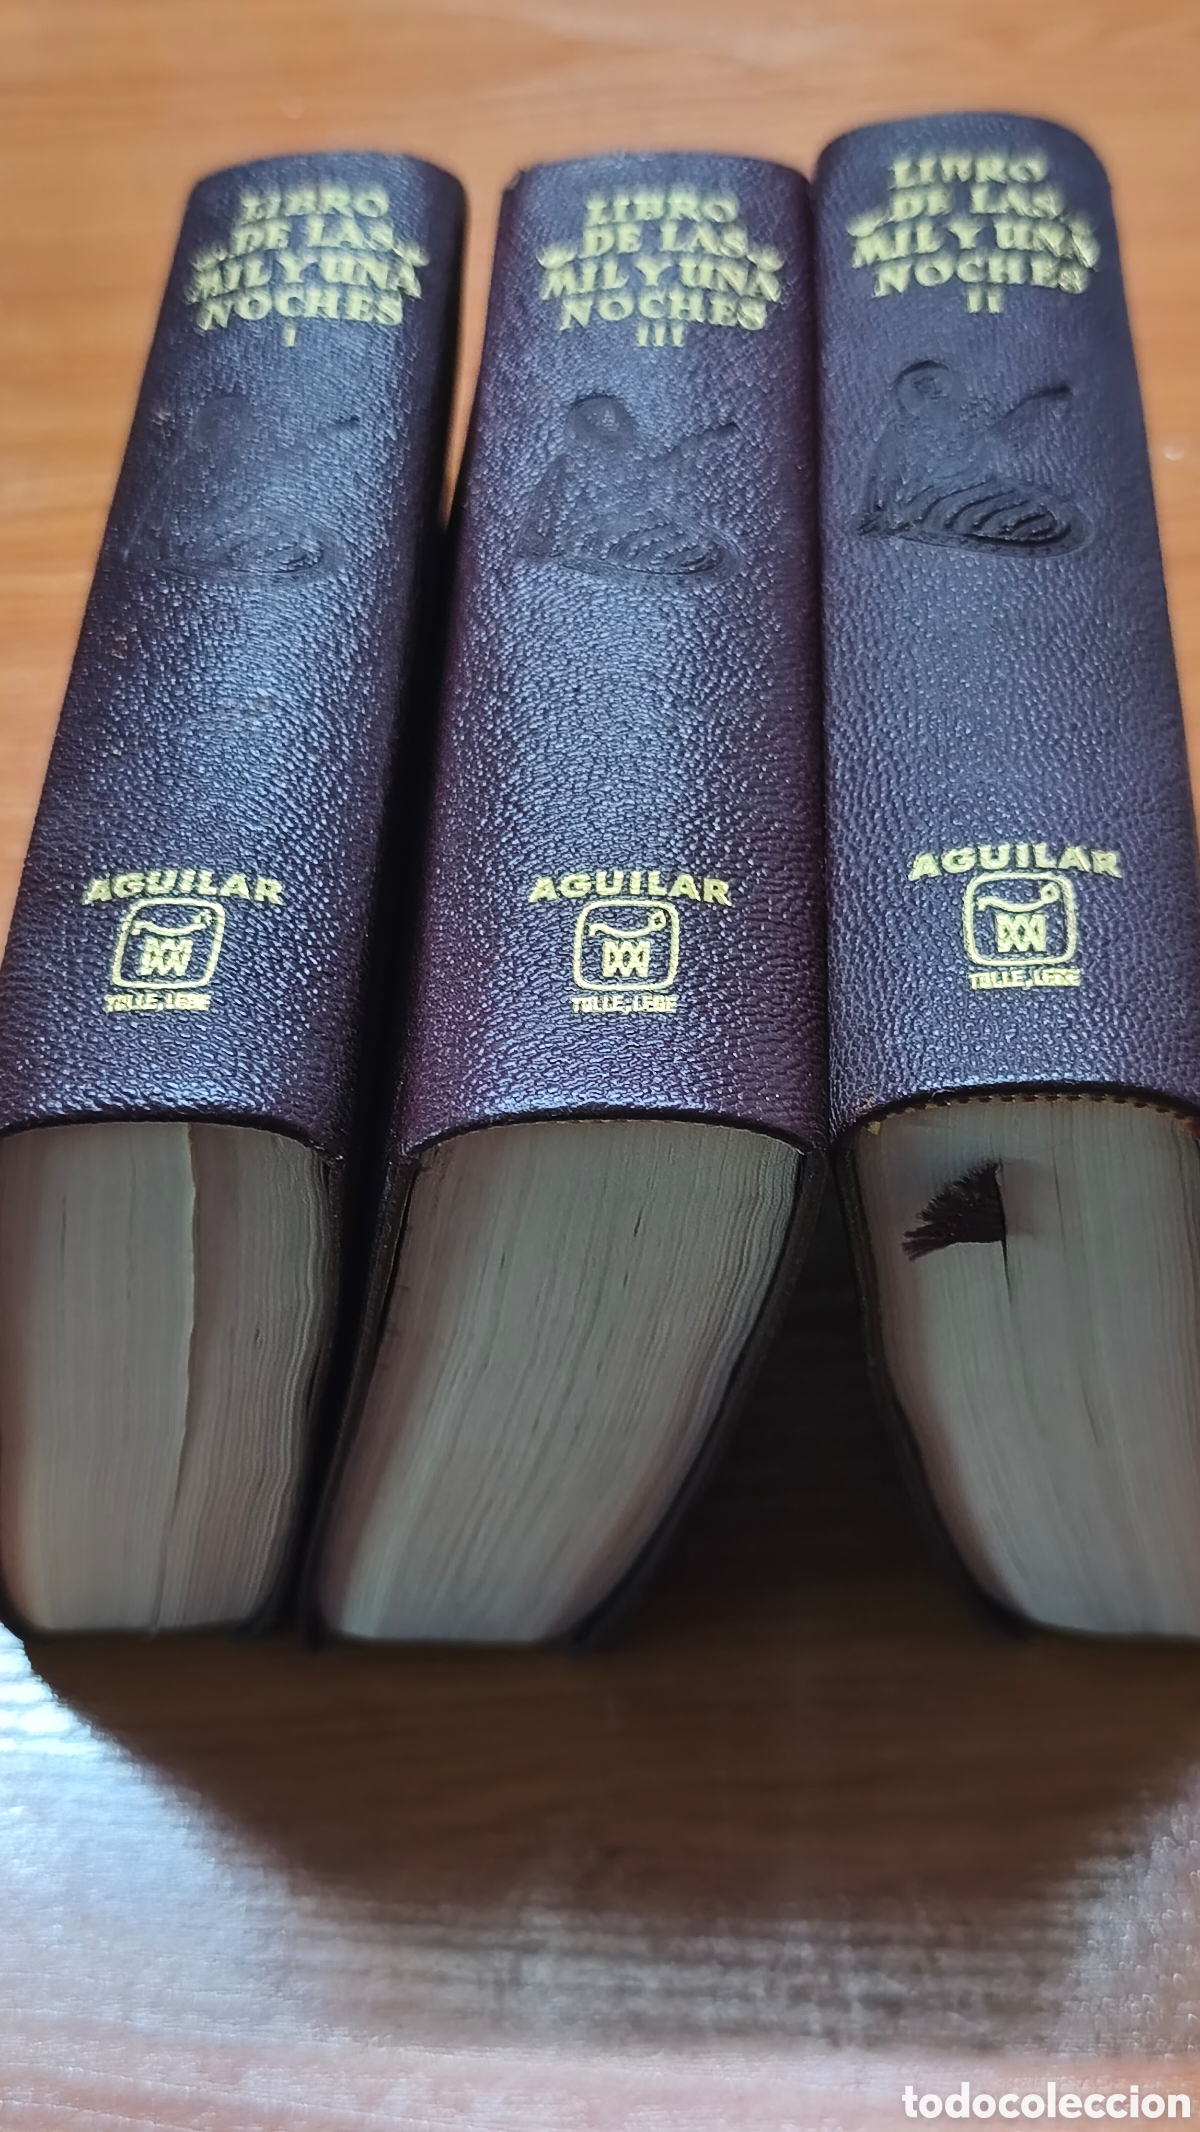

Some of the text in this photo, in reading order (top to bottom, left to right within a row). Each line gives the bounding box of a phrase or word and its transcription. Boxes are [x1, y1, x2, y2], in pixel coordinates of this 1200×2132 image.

[888, 153, 1048, 190] LIBRO
[586, 187, 740, 225] LIBRO
[888, 182, 1062, 222] DE LAS
[229, 212, 395, 259] DE LAS
[580, 220, 748, 259] DE LAS
[852, 216, 945, 269] MIL
[948, 214, 984, 250] Y
[275, 251, 320, 284] Y
[539, 252, 782, 302] MIL Y UNA
[872, 252, 1090, 297] NOCHES
[196, 286, 402, 331] NOCHES
[558, 288, 767, 331] NOCHES
[965, 283, 1003, 314] II
[635, 320, 684, 347] III
[908, 842, 1122, 882] AGUILAR
[83, 869, 284, 905] AGUILAR
[528, 869, 732, 907] AGUILAR
